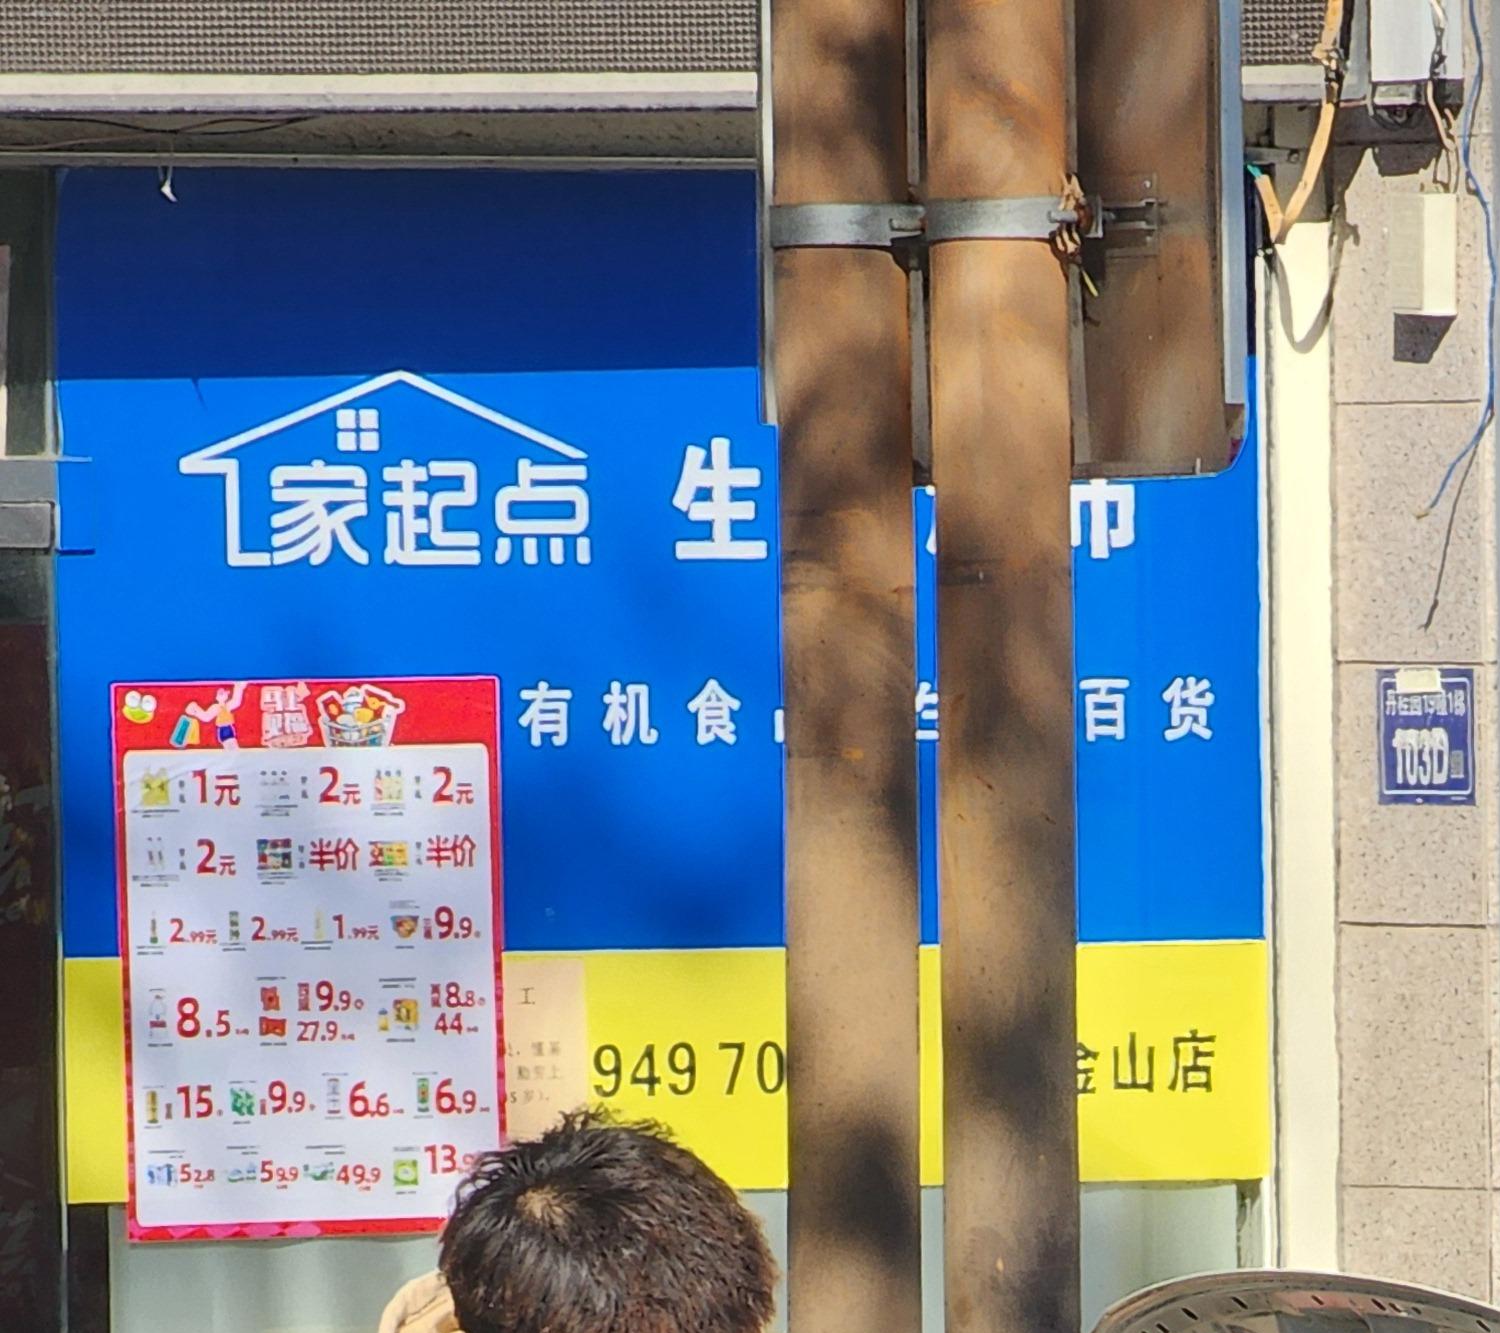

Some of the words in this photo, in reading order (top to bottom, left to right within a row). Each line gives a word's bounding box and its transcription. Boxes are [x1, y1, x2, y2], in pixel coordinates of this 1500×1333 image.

[270, 459, 591, 566] 家起点
[519, 679, 784, 747] 有机食
[191, 768, 242, 806] 1元
[318, 766, 362, 806] 2元
[431, 766, 475, 806] 2元
[196, 838, 238, 877] 2元
[308, 837, 360, 872] 半价
[426, 834, 477, 869] 半价
